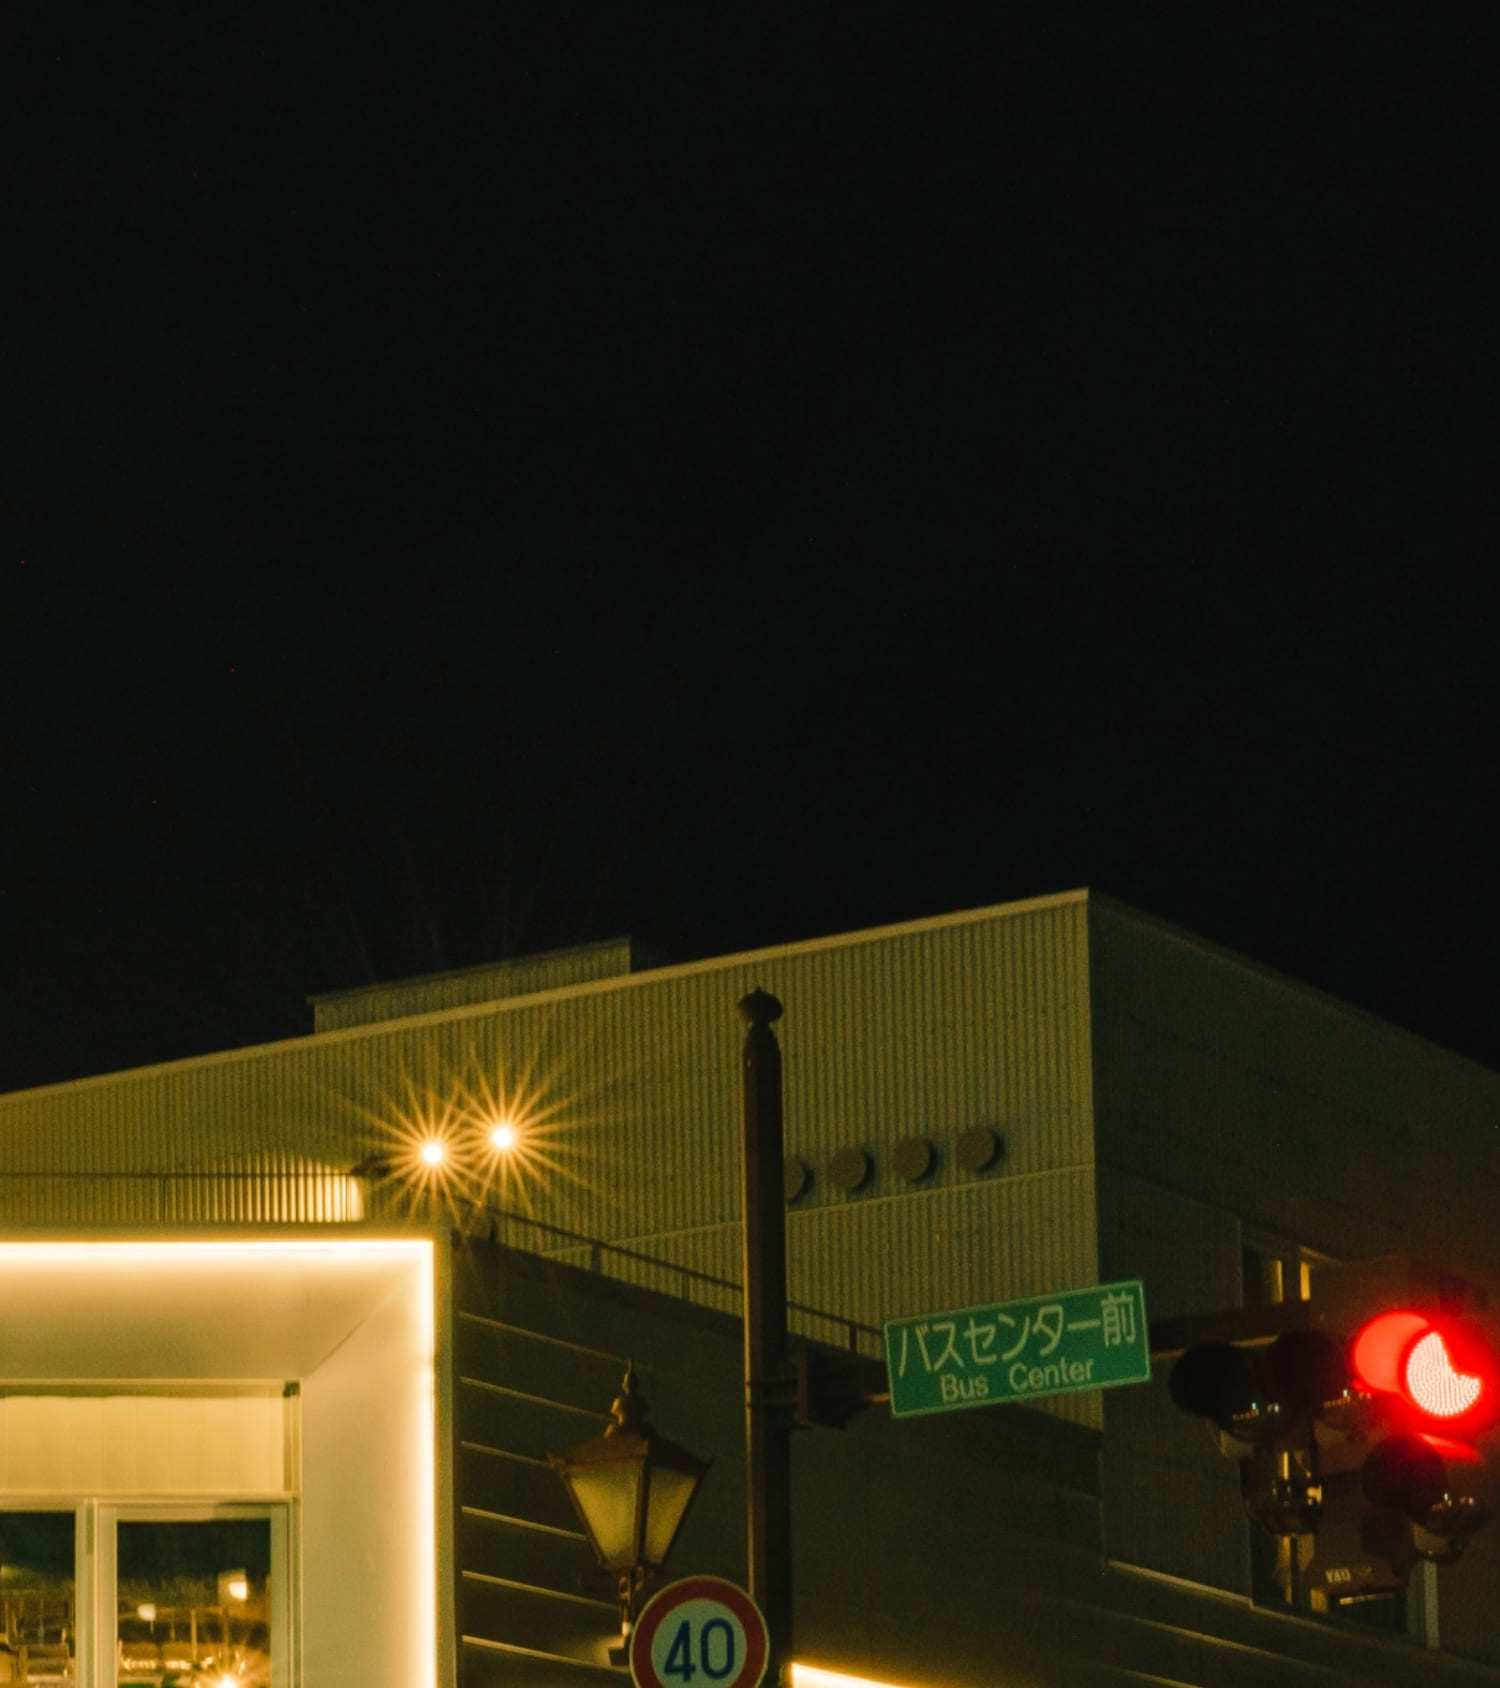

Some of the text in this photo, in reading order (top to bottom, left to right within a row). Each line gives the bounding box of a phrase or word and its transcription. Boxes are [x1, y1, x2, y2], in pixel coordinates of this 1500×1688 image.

[899, 1290, 1137, 1377] バスセンター前
[940, 1356, 1094, 1401] Bus Center
[663, 1617, 735, 1682] 40
